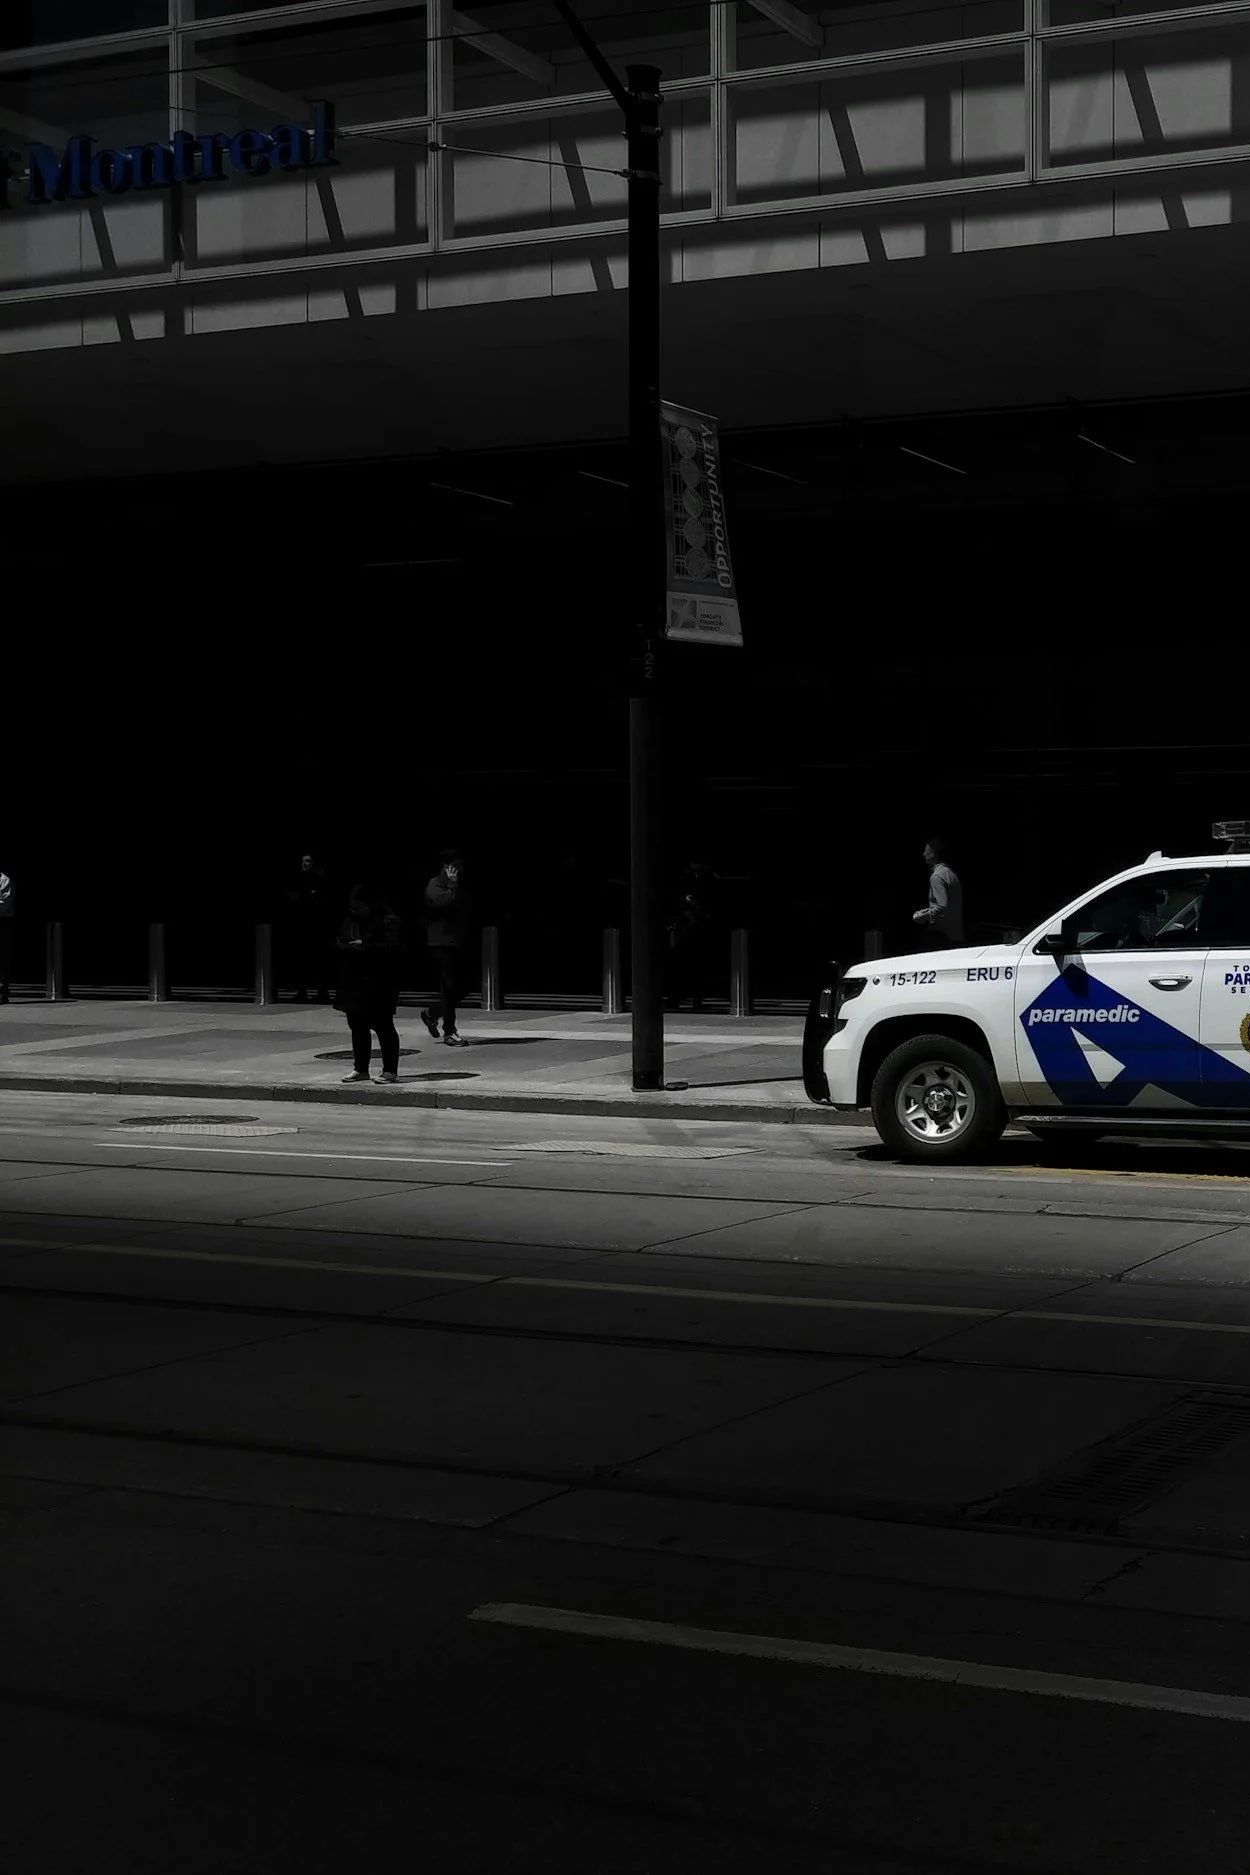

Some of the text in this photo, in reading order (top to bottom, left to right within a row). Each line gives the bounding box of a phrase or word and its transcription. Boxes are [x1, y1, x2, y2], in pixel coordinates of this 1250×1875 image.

[25, 99, 340, 204] Montreal
[700, 423, 732, 589] OPPORTUNITY
[889, 970, 937, 987] 15-122
[966, 966, 1013, 982] ERU 6
[1028, 1004, 1141, 1026] paramedic
